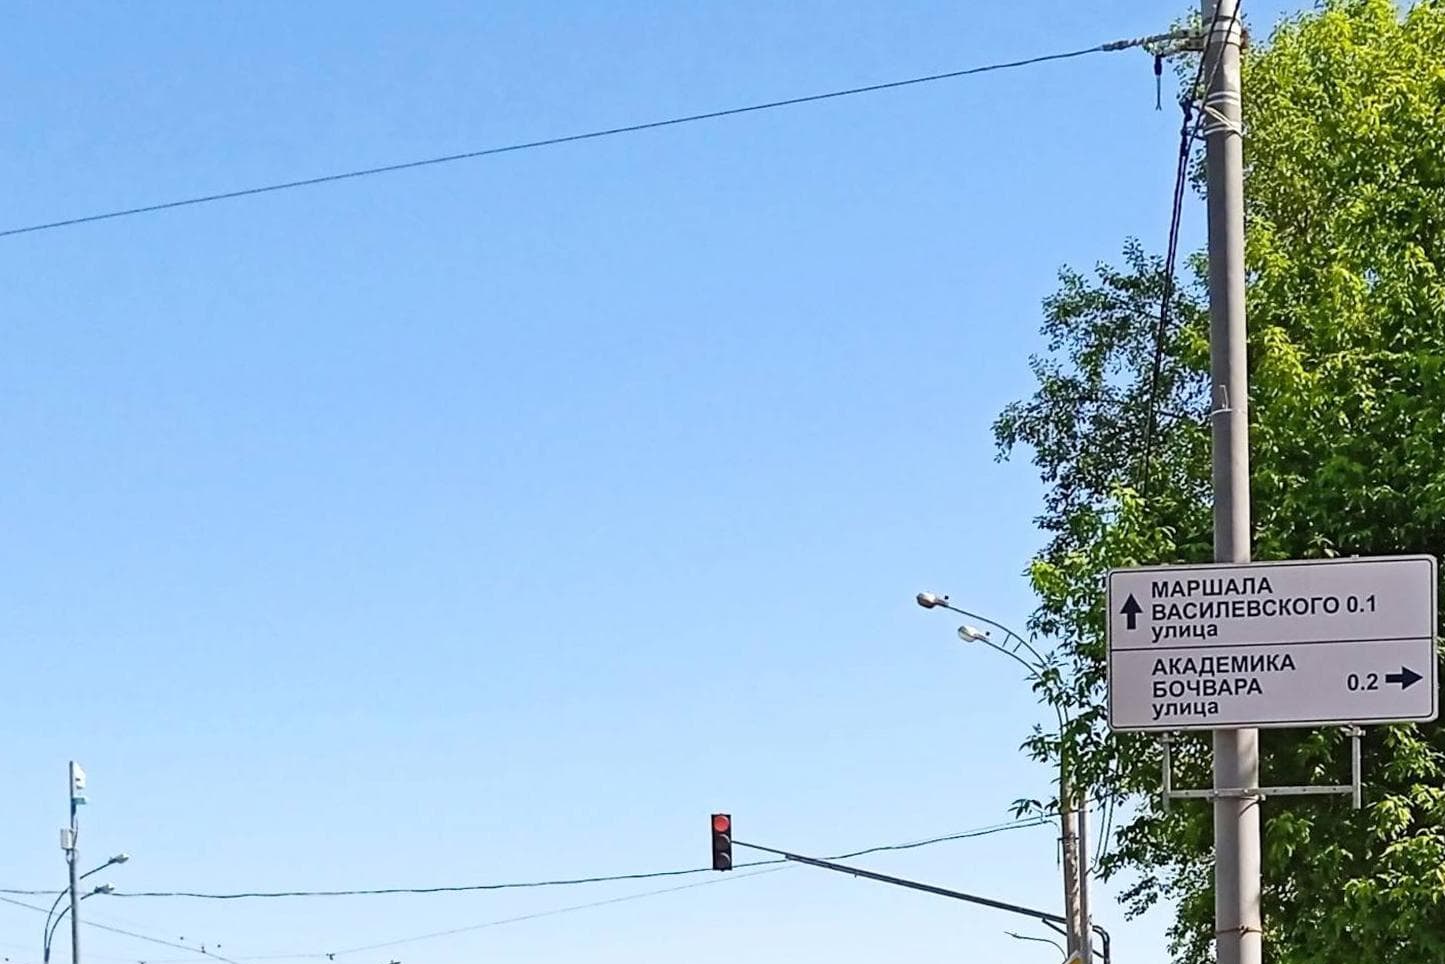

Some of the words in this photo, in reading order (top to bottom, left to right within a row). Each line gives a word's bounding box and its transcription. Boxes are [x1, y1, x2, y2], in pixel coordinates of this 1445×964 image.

[1152, 577, 1273, 598] МАРШАЛА
[1152, 597, 1340, 620] ВАСИЛЕВСКОГО
[1347, 595, 1376, 613] 0.1
[1152, 622, 1218, 642] улица
[1152, 654, 1296, 677] АКАДЕМИКА
[1153, 678, 1263, 698] БОЧВАРА
[1347, 673, 1379, 691] 0.2
[1152, 701, 1219, 720] улица
